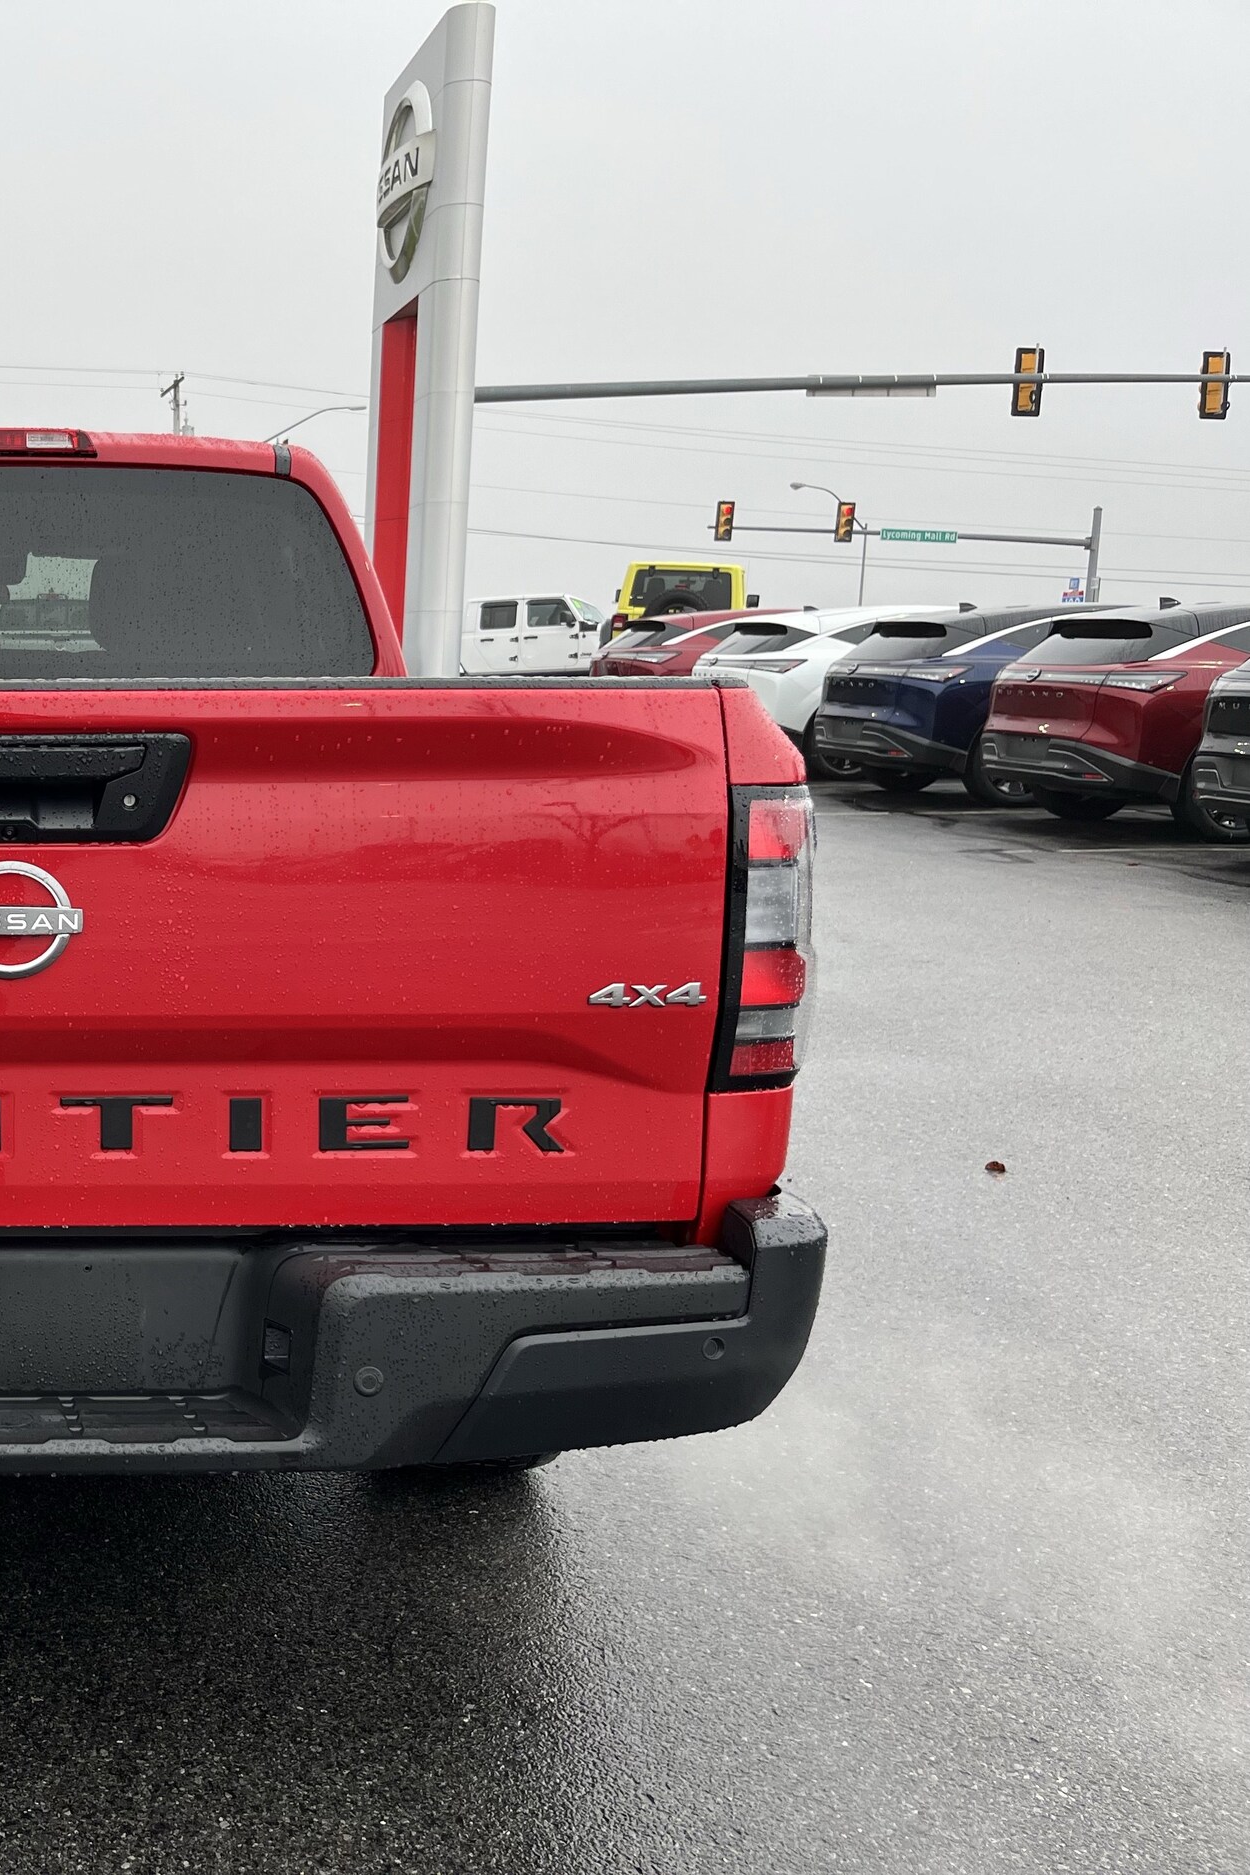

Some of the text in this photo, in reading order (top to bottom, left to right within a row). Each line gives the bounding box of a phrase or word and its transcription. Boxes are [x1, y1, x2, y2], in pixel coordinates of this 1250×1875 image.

[378, 147, 419, 204] SSAN
[882, 530, 956, 541] Lycoming Mall Rd
[1218, 702, 1250, 710] MU
[588, 982, 707, 1007] 4x4
